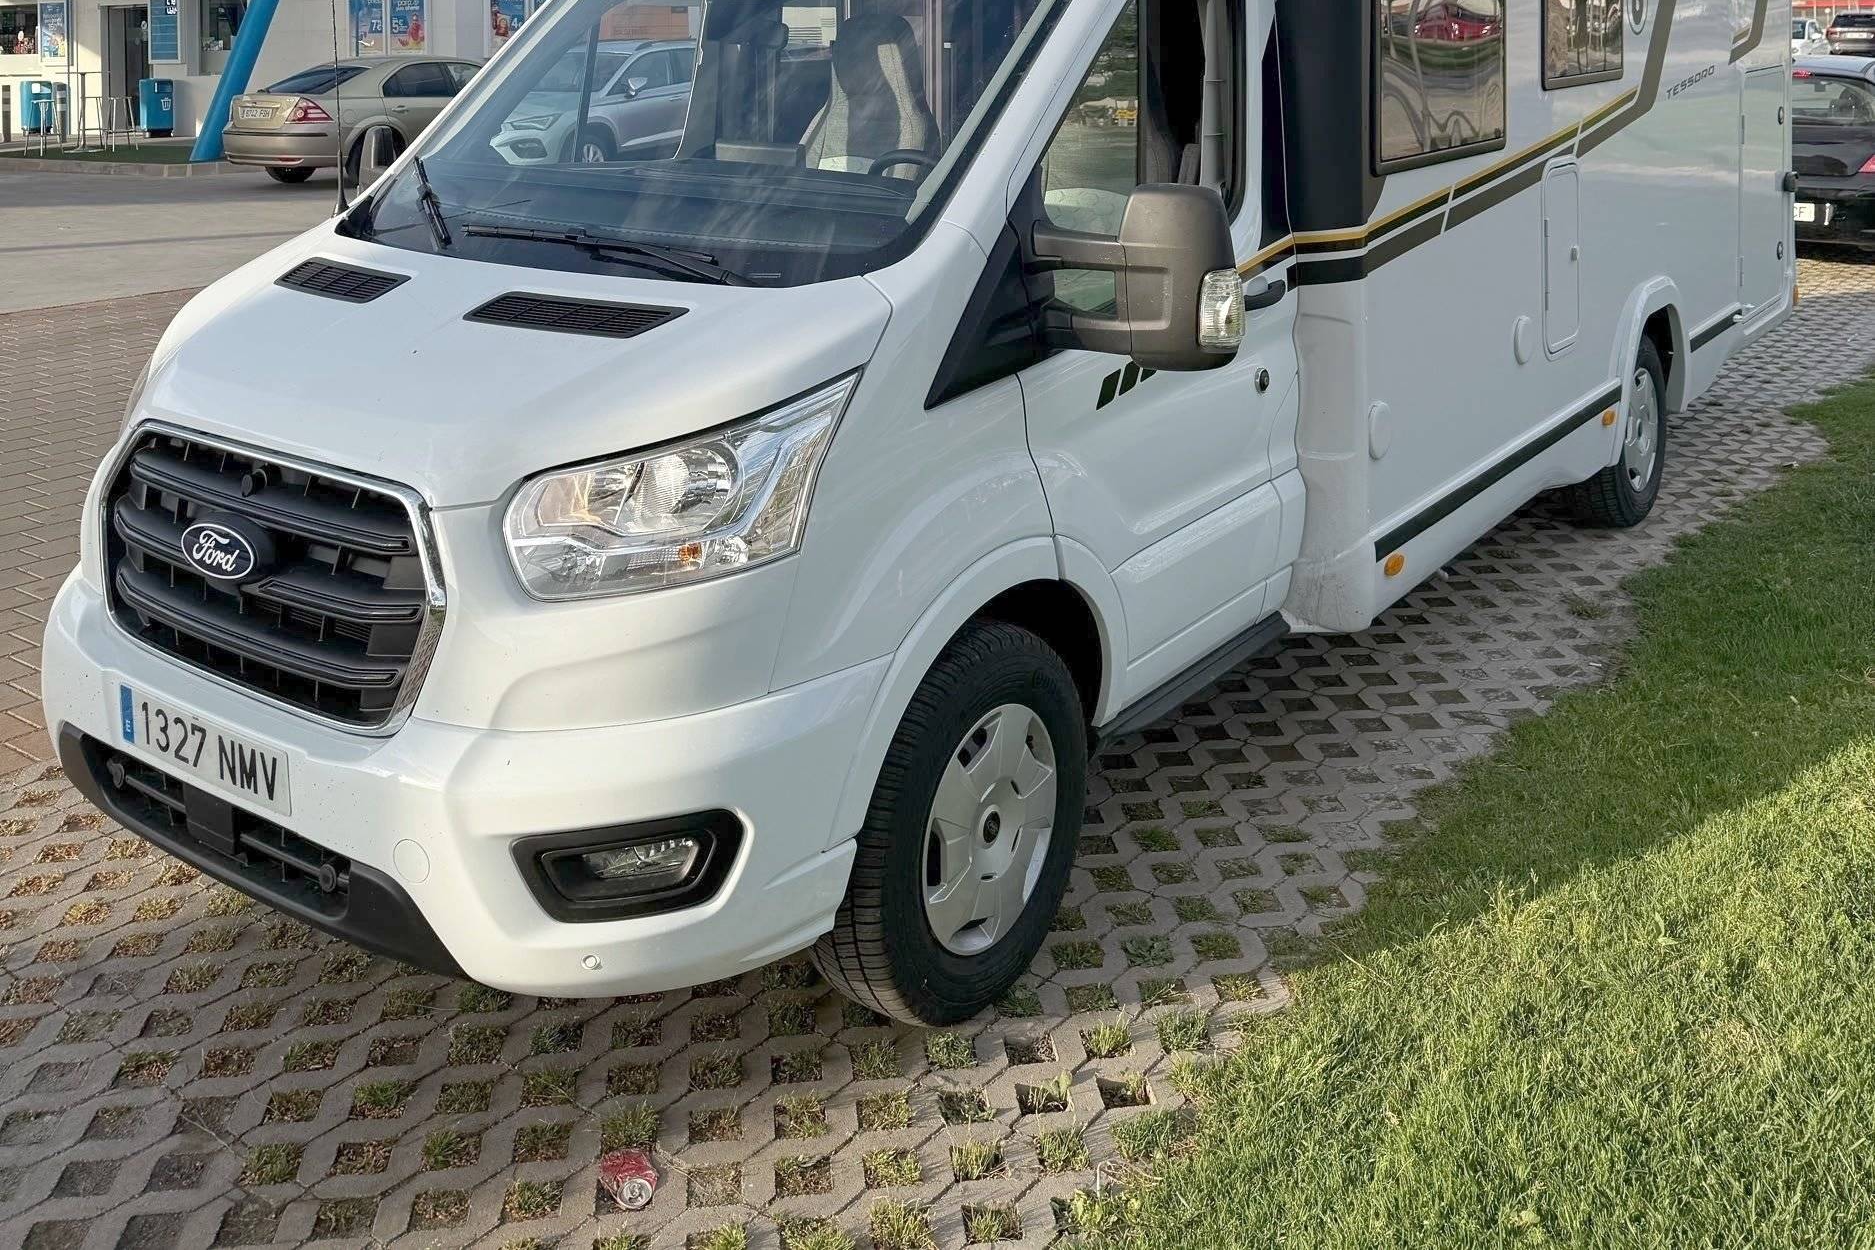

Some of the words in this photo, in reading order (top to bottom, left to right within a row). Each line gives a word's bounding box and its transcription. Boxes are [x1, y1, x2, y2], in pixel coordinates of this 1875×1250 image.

[1666, 65, 1716, 100] TESSORO
[192, 530, 240, 572] Ford
[141, 701, 207, 768] 1327
[218, 734, 278, 801] NMV
